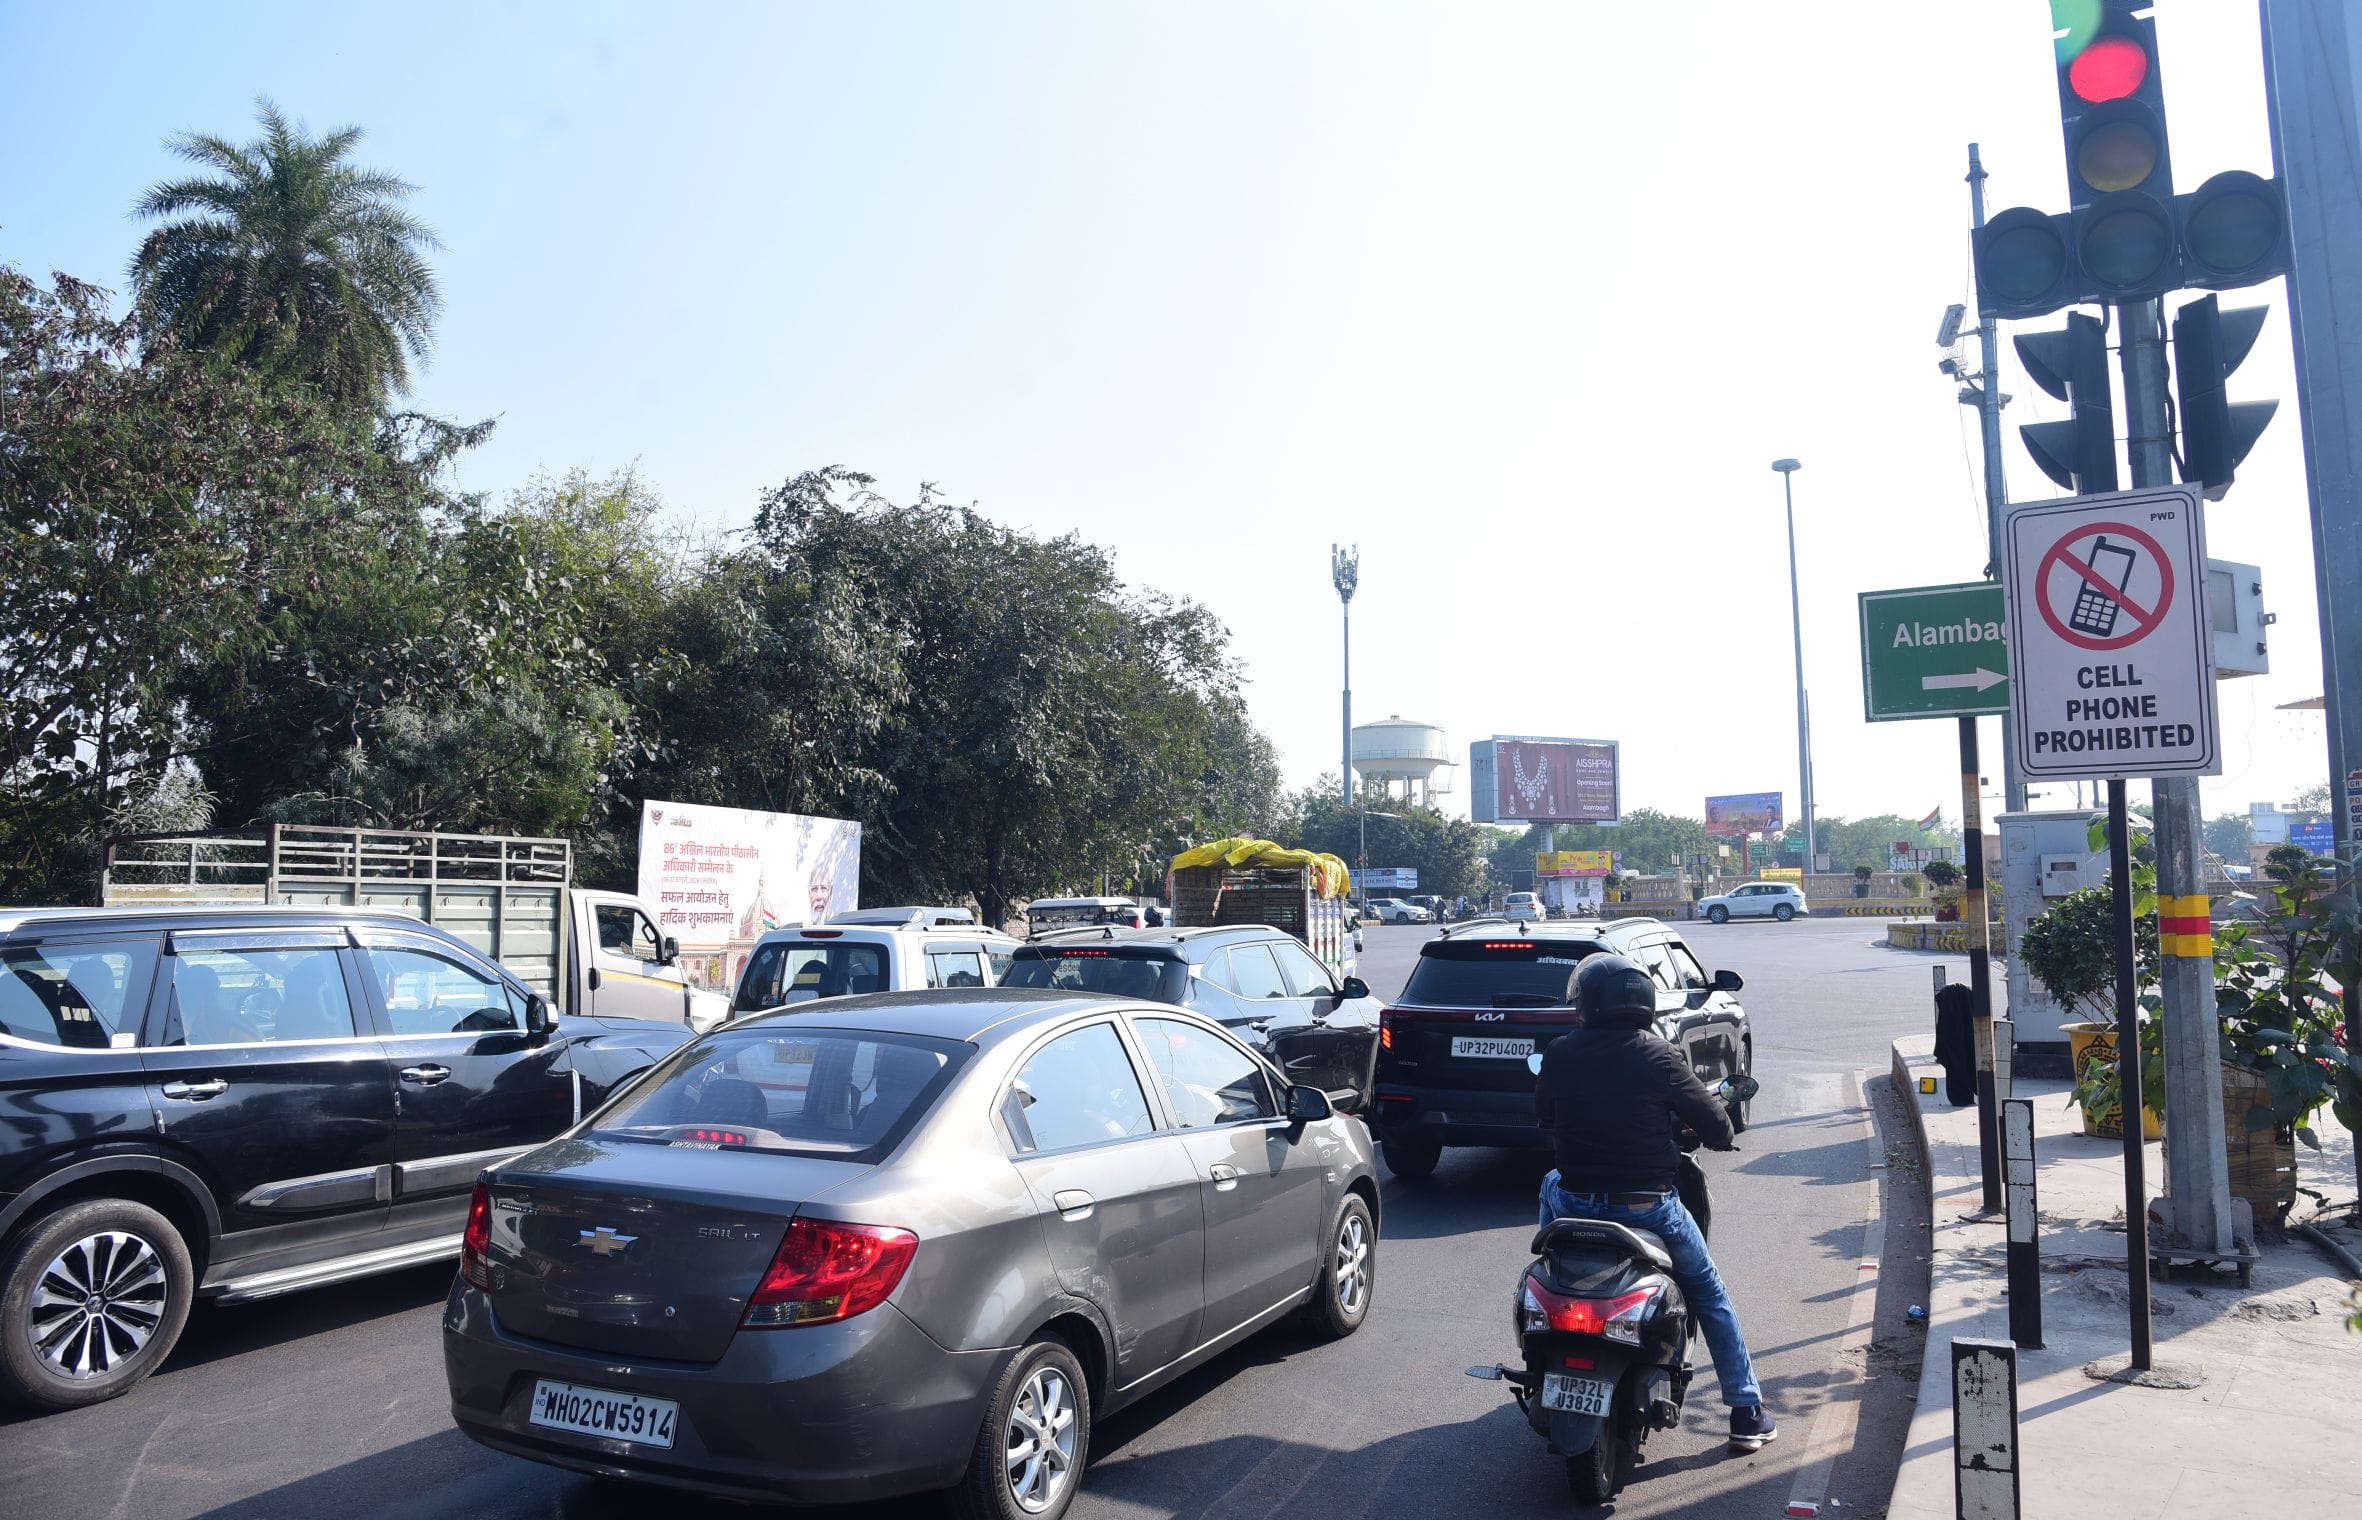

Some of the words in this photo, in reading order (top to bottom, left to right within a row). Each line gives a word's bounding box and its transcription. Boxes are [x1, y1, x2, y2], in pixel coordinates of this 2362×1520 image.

[2150, 511, 2175, 521] PWD
[2077, 664, 2142, 689] CELL
[2066, 695, 2157, 721] PHONE
[2034, 724, 2194, 753] PROHIBITED
[679, 840, 704, 856] अखिल
[705, 843, 730, 857] भारतीय
[731, 844, 759, 860] पीठासीन
[662, 857, 696, 872] अधिकारी
[698, 859, 724, 874] सम्मेलन
[726, 861, 734, 874] के
[661, 891, 684, 903] सफल
[686, 888, 717, 904] आयोजन
[718, 889, 730, 908] हेतु
[660, 908, 687, 925] हार्दिक
[688, 909, 734, 929] शुभकामनाएं
[1459, 1041, 1533, 1056] UP32PU4002
[669, 1141, 721, 1151] ASHTAVINAYAK
[1560, 1377, 1604, 1399] UP32L
[1557, 1392, 1602, 1414] U3820
[544, 1391, 673, 1439] MH02CW5914
